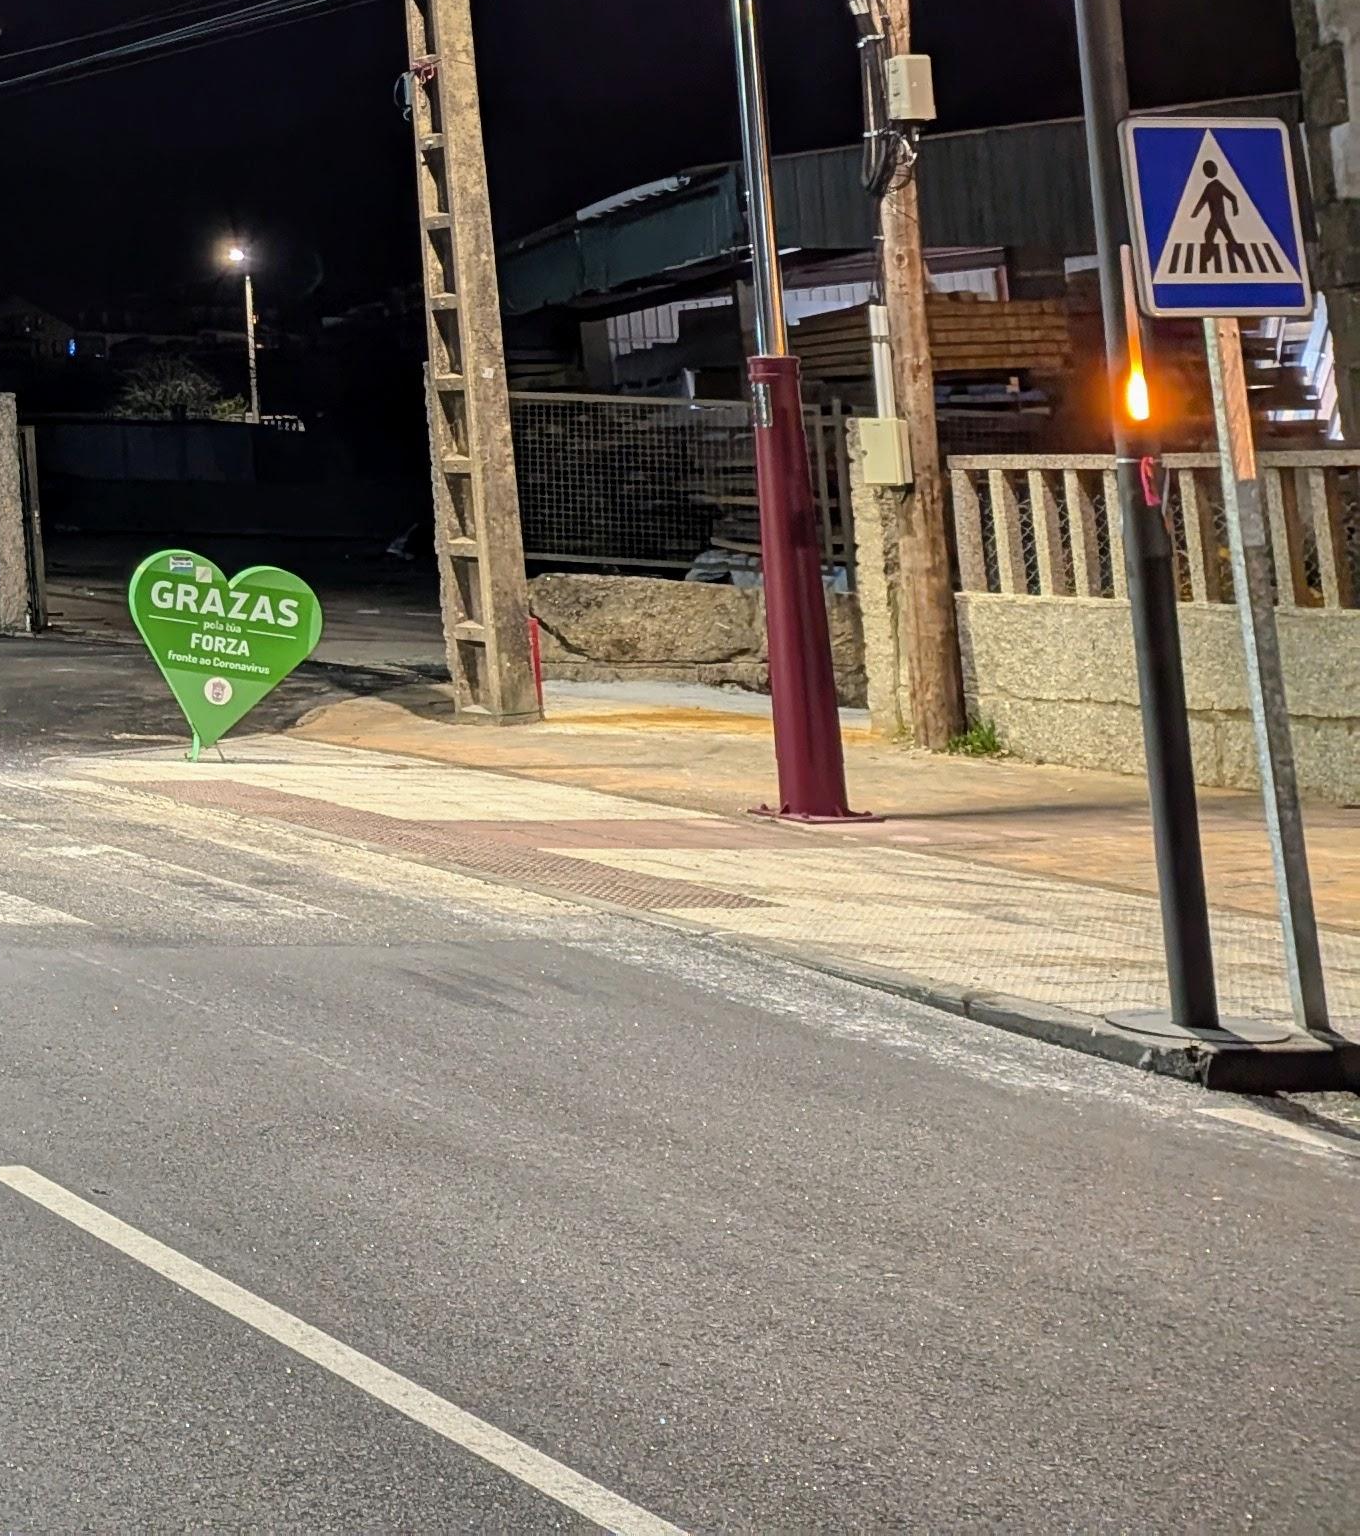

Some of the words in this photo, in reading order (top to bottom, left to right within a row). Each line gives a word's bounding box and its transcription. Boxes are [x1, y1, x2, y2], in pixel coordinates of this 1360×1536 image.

[150, 580, 300, 628] GRAZAS
[203, 620, 224, 631] pola
[190, 632, 250, 657] FORZA
[167, 649, 198, 664] fronte
[198, 656, 212, 666] ao
[212, 656, 270, 675] Coronavirus
